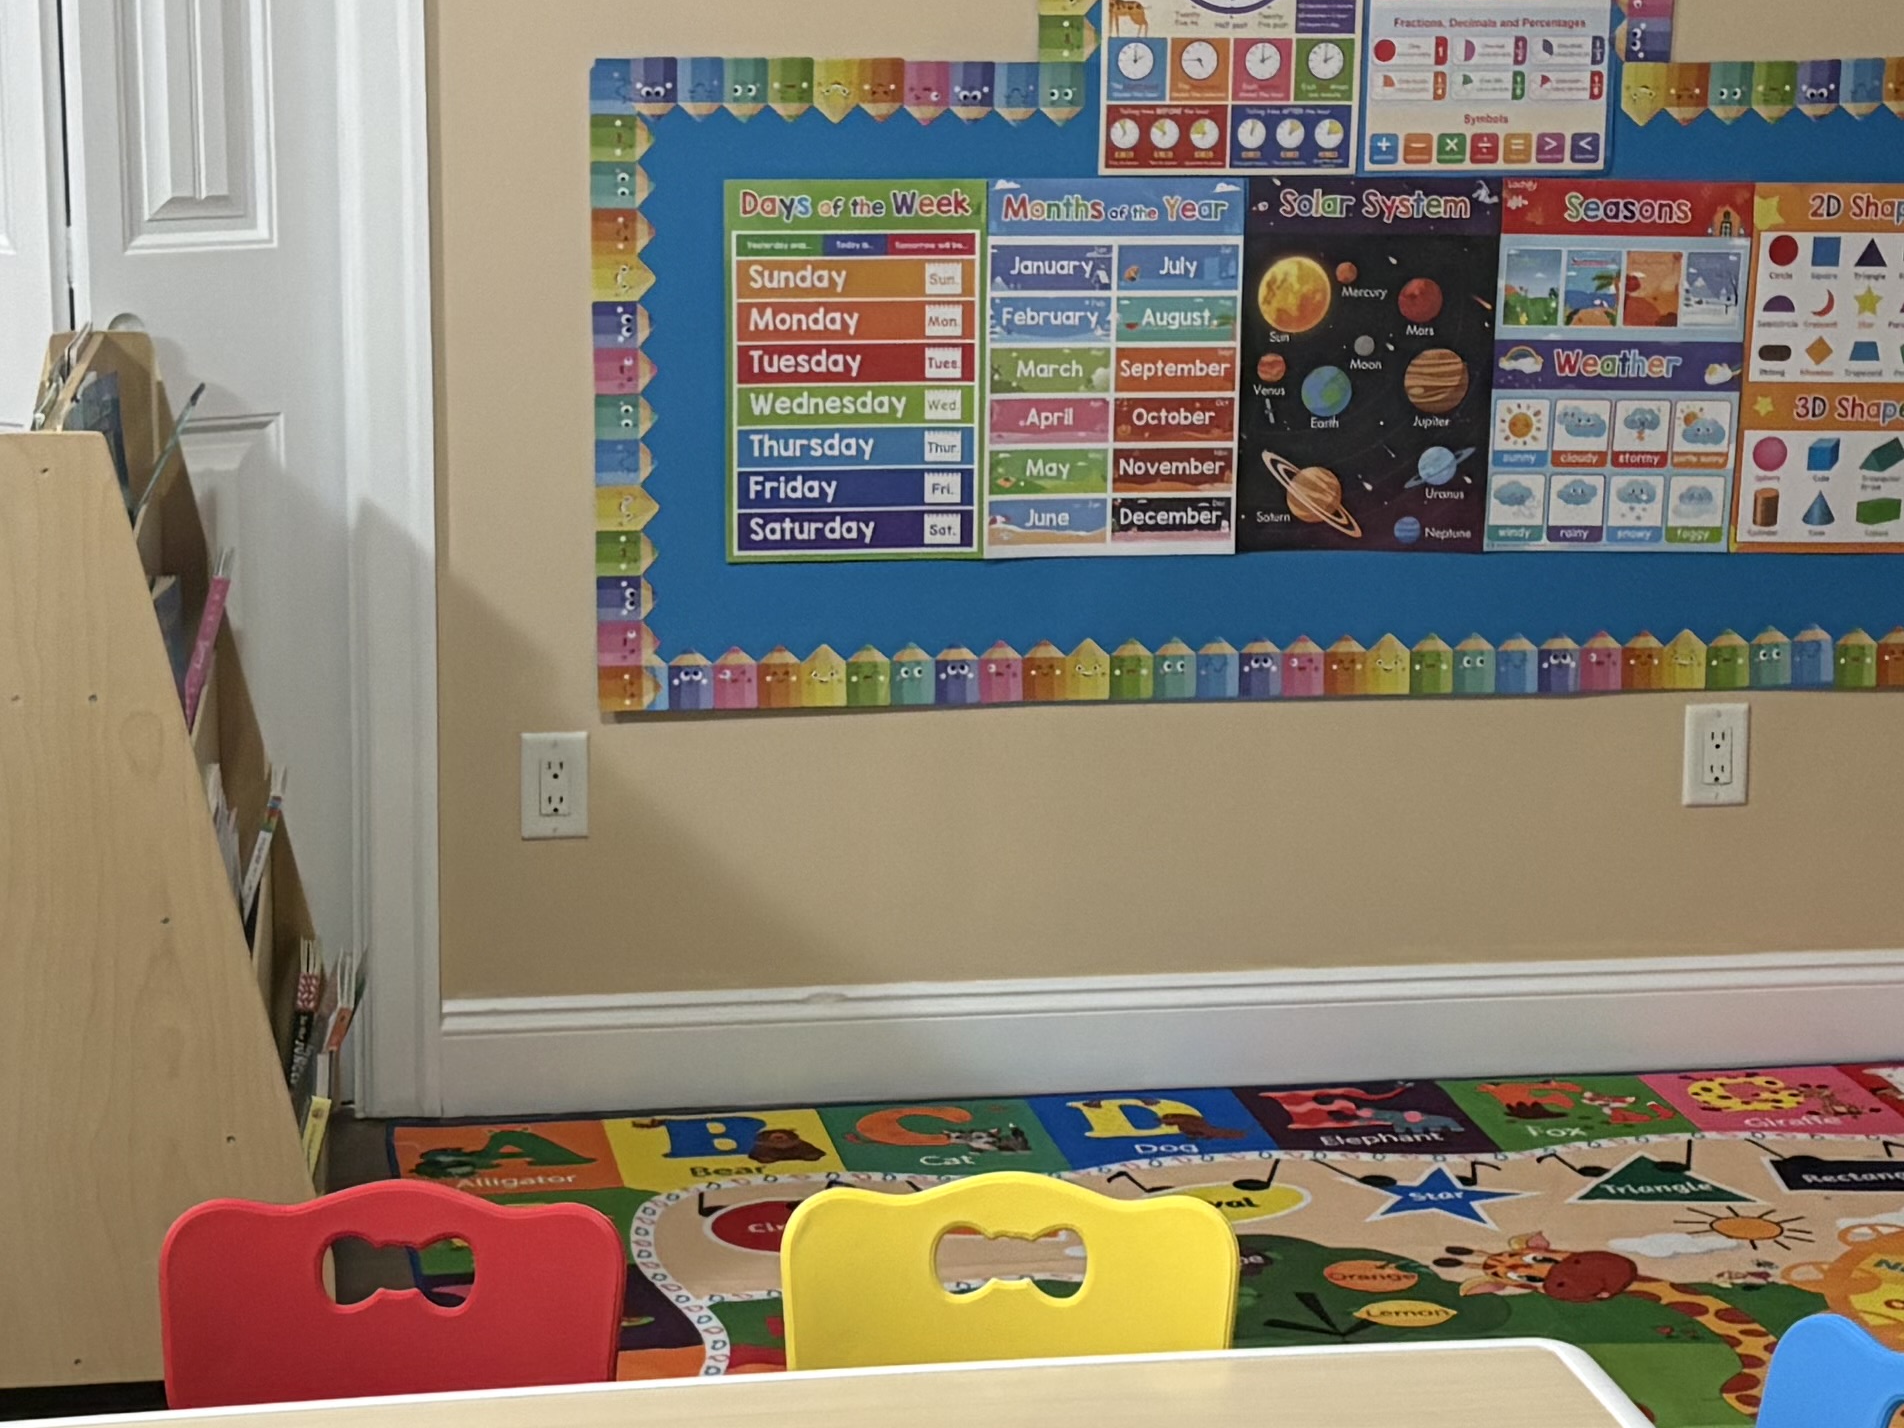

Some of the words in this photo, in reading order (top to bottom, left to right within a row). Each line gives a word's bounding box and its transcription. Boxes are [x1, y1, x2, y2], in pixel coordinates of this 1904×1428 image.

[1394, 18, 1445, 29] Fractions,
[1449, 18, 1496, 28] Decimals
[1500, 18, 1519, 28] and
[1523, 18, 1585, 30] Percentages
[1464, 114, 1508, 125] Symbols
[740, 190, 812, 223] Days
[818, 196, 844, 217] of
[851, 196, 884, 217] the
[891, 189, 972, 216] Week
[1003, 193, 1105, 222] Months
[1108, 207, 1128, 222] of
[1131, 203, 1158, 221] the
[1163, 195, 1228, 222] Year
[1279, 189, 1355, 218] Solar
[1362, 189, 1471, 223] System
[1564, 192, 1692, 224] Seasons
[1808, 195, 1842, 221] 2D
[1010, 256, 1093, 278] January
[1159, 256, 1197, 279] July
[749, 264, 847, 292] Sunday
[1341, 286, 1387, 300] Mercury
[749, 307, 859, 335] Monday
[1002, 307, 1099, 328] February
[1142, 308, 1211, 329] August
[1269, 332, 1290, 343] Sun
[1406, 324, 1434, 336] Mars
[749, 349, 862, 377] Tuesday
[1016, 360, 1083, 379] March
[1120, 359, 1231, 379] September
[1350, 359, 1382, 370] Moon
[1554, 348, 1682, 378] Weather
[1253, 385, 1286, 396] Venus
[749, 391, 907, 418] Wednesday
[1794, 396, 1827, 420] 3D
[1026, 407, 1073, 428] April
[1132, 407, 1215, 427] October
[1310, 417, 1339, 429] Earth
[1413, 416, 1450, 429] Jupiter
[749, 434, 874, 460] Thursday
[1502, 452, 1537, 465] sunny
[1560, 452, 1599, 465] cloudy
[1618, 452, 1660, 465] stormy
[1026, 459, 1070, 480] May
[1119, 458, 1225, 476] November
[749, 476, 837, 502] Friday
[1425, 488, 1464, 499] Uranus
[1024, 509, 1070, 527] June
[1120, 507, 1222, 526] December
[1256, 511, 1291, 523] Saturn
[749, 517, 875, 543] Saturday
[1424, 527, 1471, 539] Neptune
[1497, 527, 1532, 540] windy
[1558, 527, 1589, 540] rainy
[1617, 527, 1652, 540] snowy
[1677, 527, 1711, 541] foggy
[1744, 1115, 1842, 1128] Giraffe
[1320, 1131, 1444, 1147] Elephant
[1526, 1125, 1587, 1139] Fox
[1133, 1142, 1199, 1157] Dog
[918, 1153, 974, 1168] Cat
[690, 1165, 768, 1178] Bear
[456, 1172, 577, 1190] Alligator
[1600, 1181, 1713, 1196] Triangle
[1408, 1190, 1464, 1200] Star
[1328, 1272, 1417, 1284] Orange
[1365, 1307, 1449, 1318] Lemon
